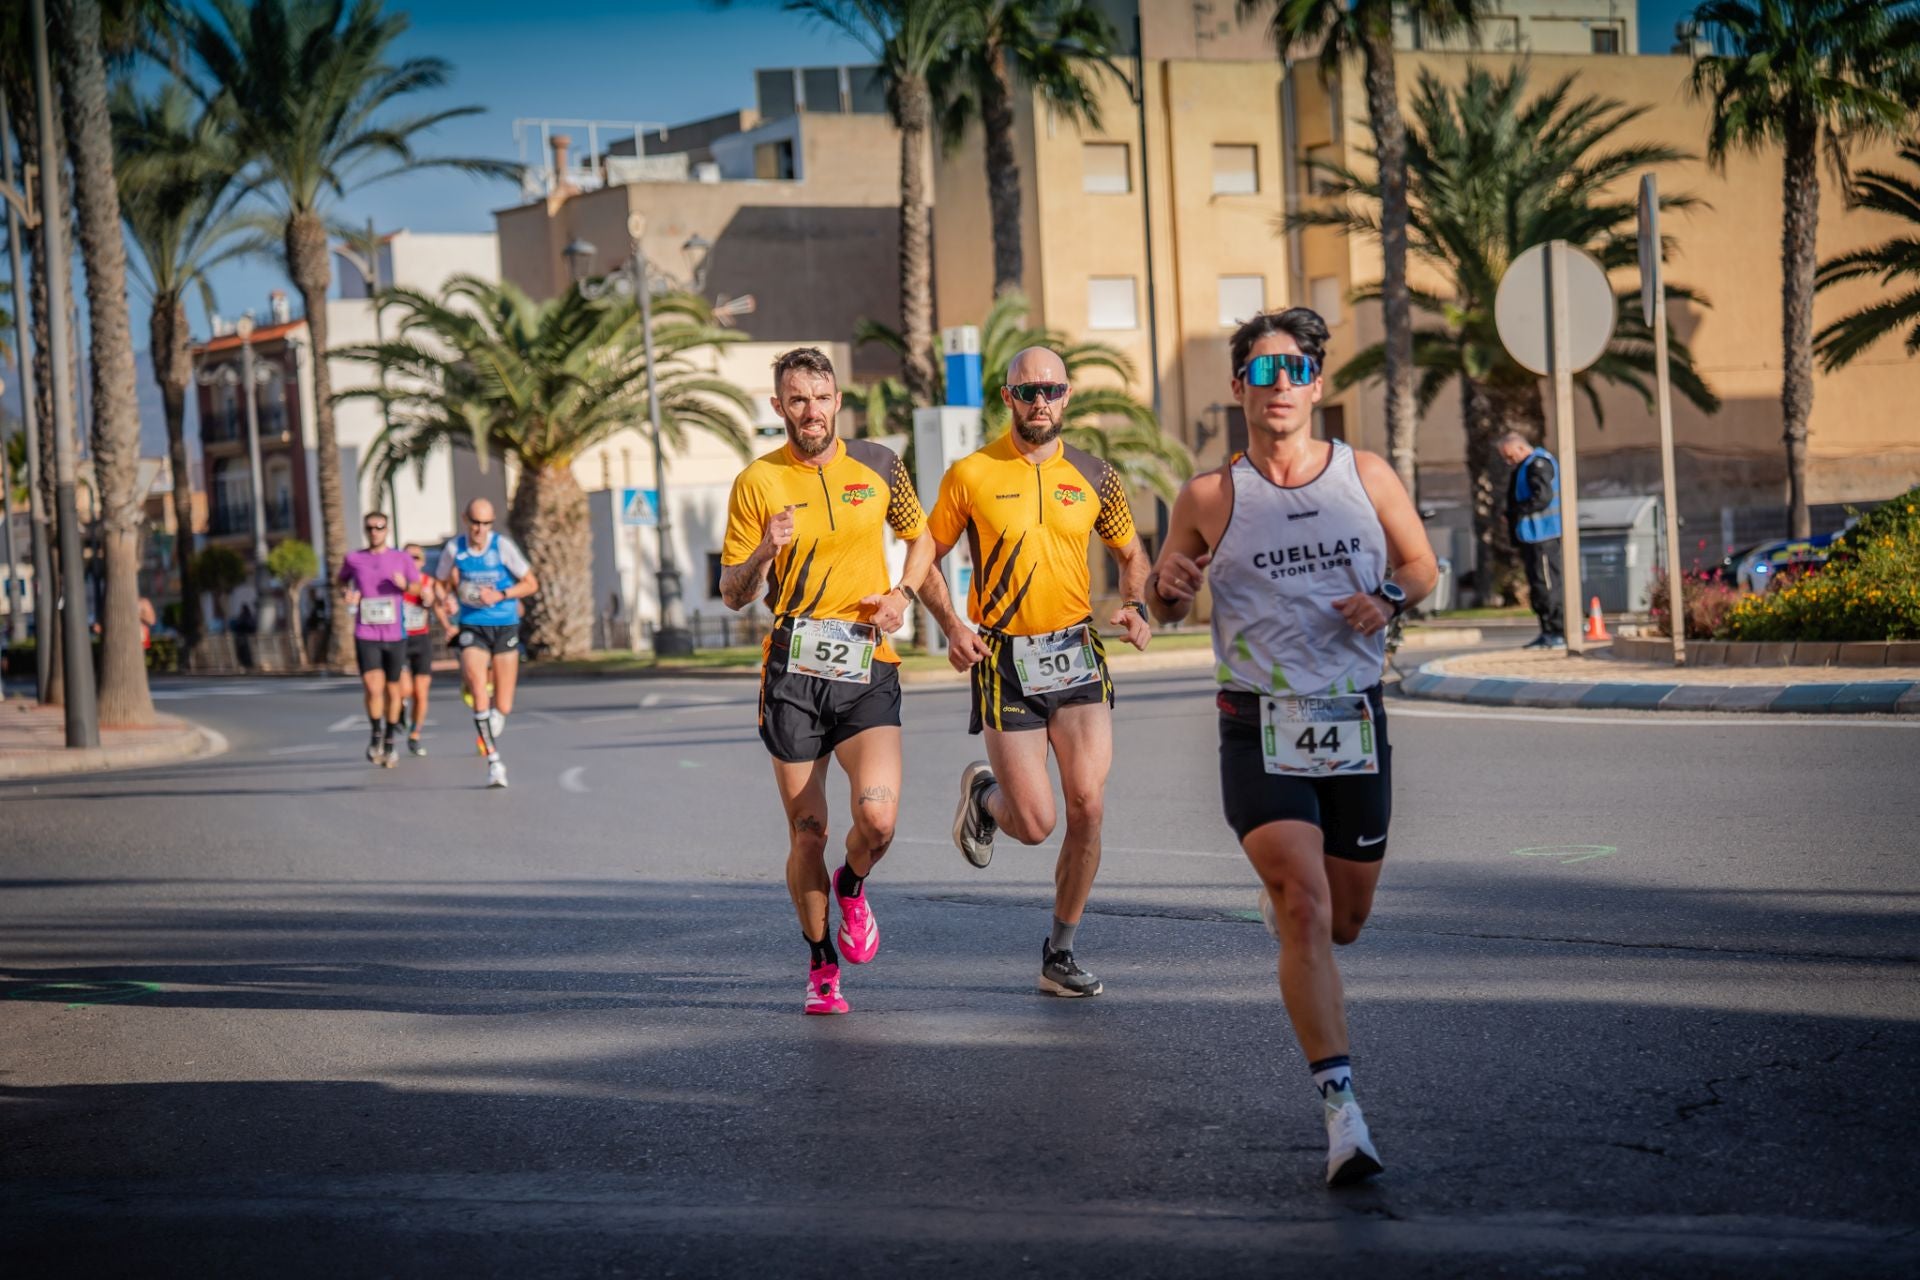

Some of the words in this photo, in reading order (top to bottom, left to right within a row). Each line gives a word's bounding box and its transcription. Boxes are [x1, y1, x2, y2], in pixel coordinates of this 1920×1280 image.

[1253, 537, 1361, 569] CUELLAR
[1270, 563, 1316, 580] STONE
[815, 641, 849, 665] 52
[1039, 653, 1070, 677] 50
[1295, 726, 1341, 754] 44
